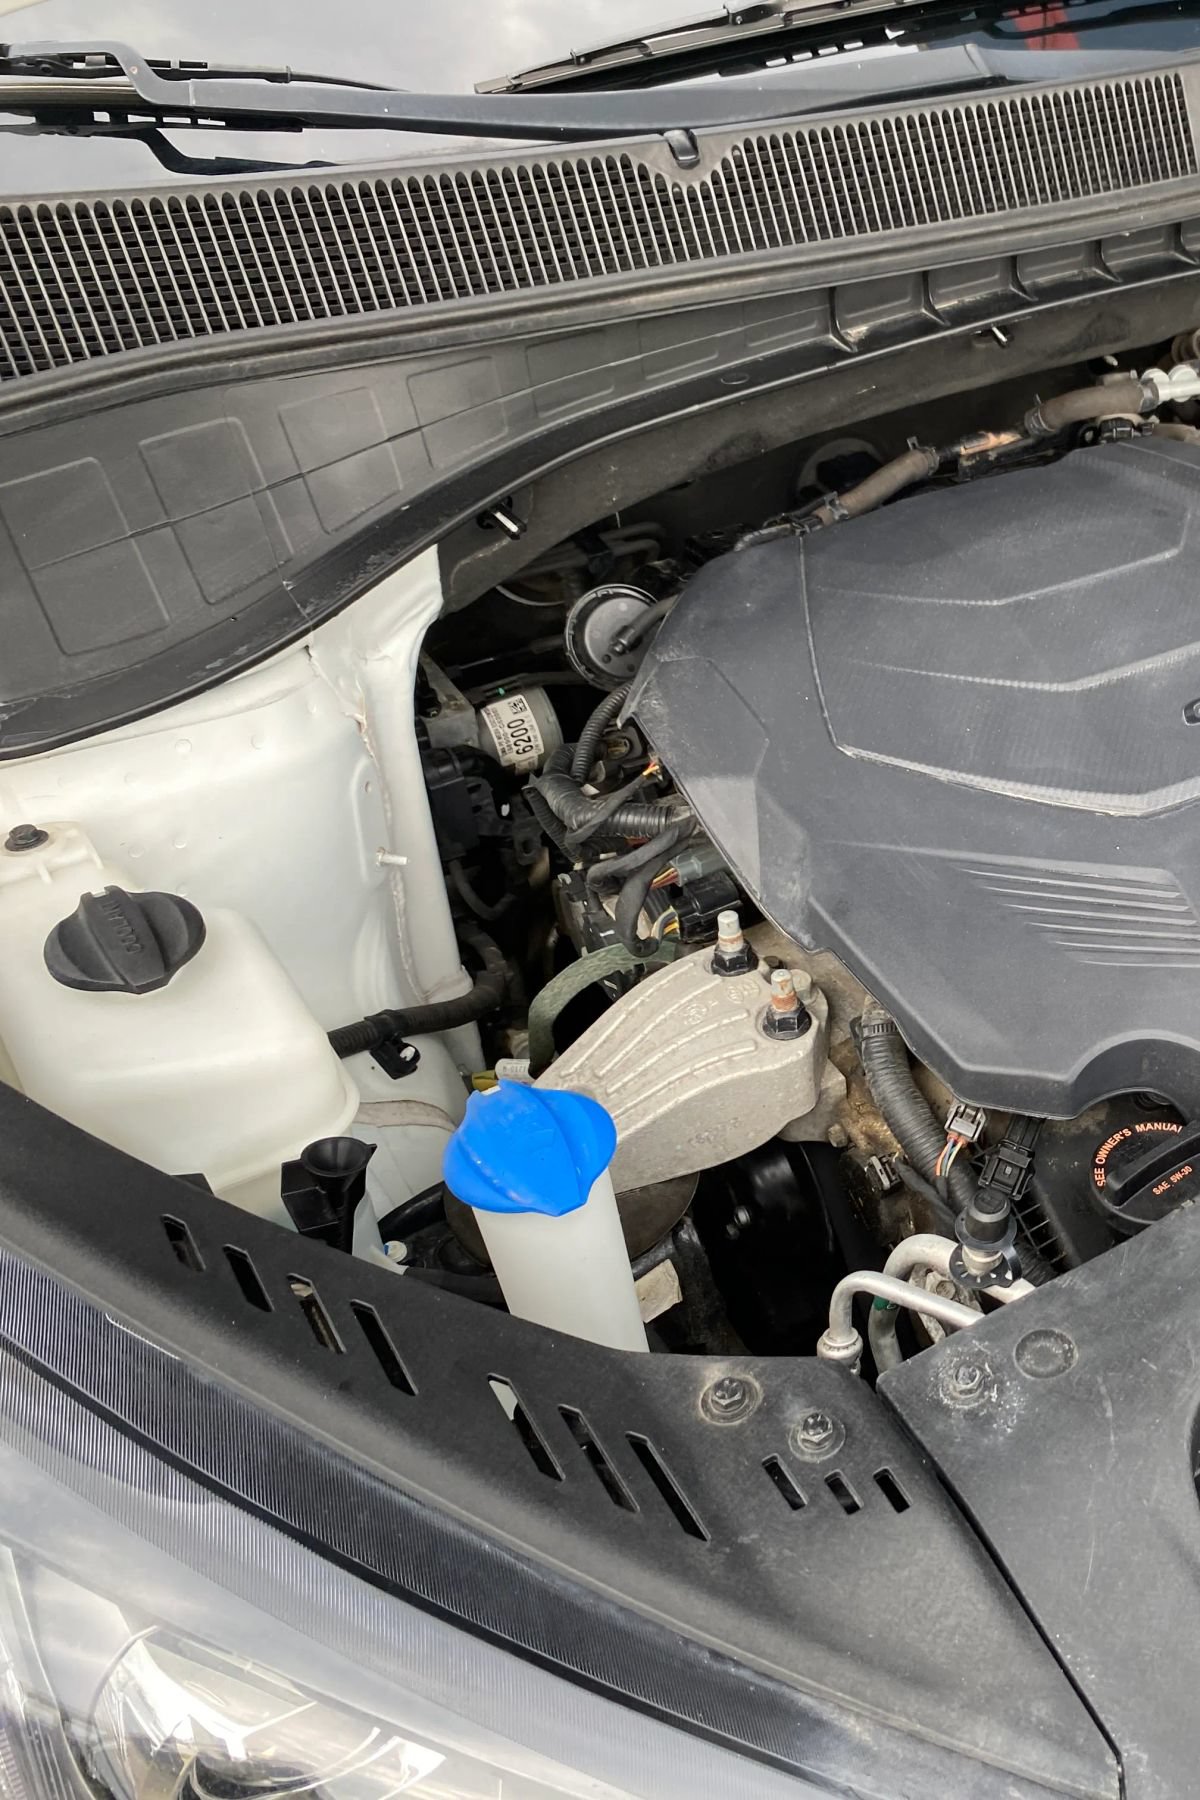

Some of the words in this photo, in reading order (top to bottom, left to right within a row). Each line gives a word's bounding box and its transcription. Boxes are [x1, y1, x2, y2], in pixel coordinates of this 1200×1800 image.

[507, 718, 534, 755] 6200
[1095, 1128, 1132, 1165] OWNER'S
[1094, 1167, 1106, 1187] SEE
[1152, 1180, 1171, 1195] SAE
[1169, 1165, 1193, 1183] 5W-30
